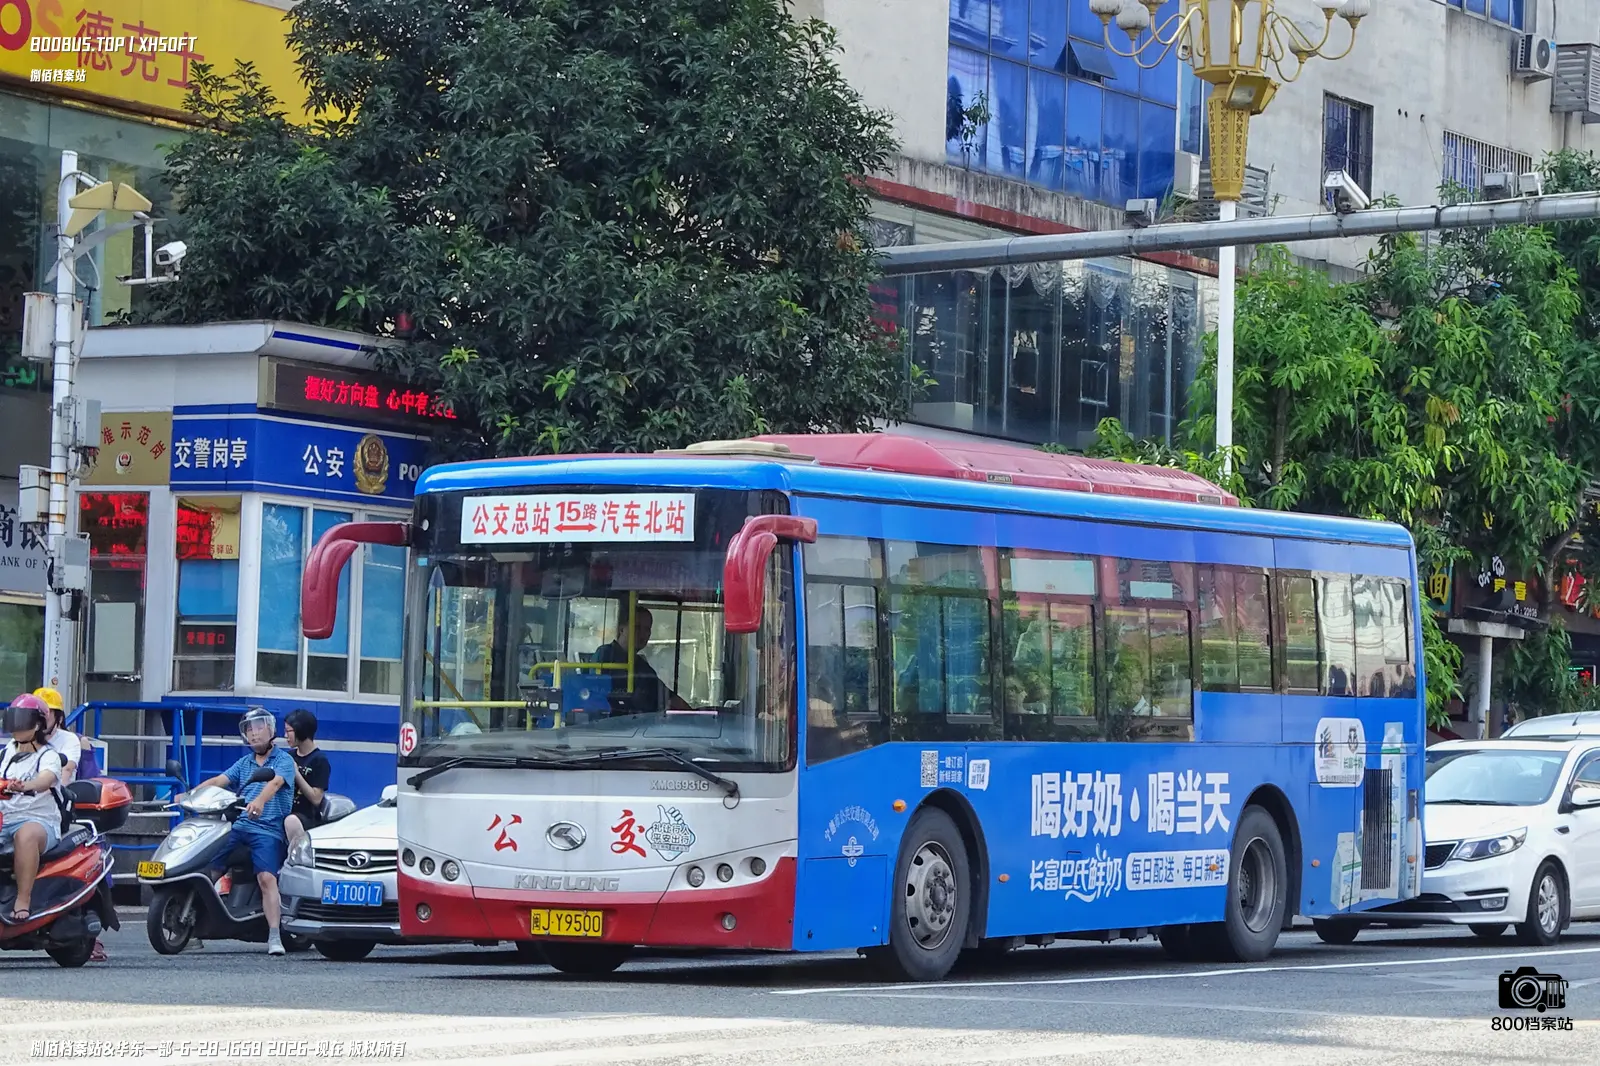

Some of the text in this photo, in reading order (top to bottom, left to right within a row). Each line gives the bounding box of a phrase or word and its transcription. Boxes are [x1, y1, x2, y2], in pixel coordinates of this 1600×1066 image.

[75, 8, 205, 89] 德克士
[304, 375, 380, 408] 握好方向盘
[174, 436, 248, 469] 交警岗亭
[302, 443, 345, 479] 公安
[472, 500, 686, 536] 公交总站 15路 汽车北站
[25, 557, 37, 569] OF
[401, 727, 414, 752] 15
[650, 780, 710, 791] XMQ6931G
[1030, 770, 1231, 839] 喝好奶 喝当天
[486, 809, 647, 858] 公 交
[1029, 842, 1123, 902] 长富巴氏鲜奶
